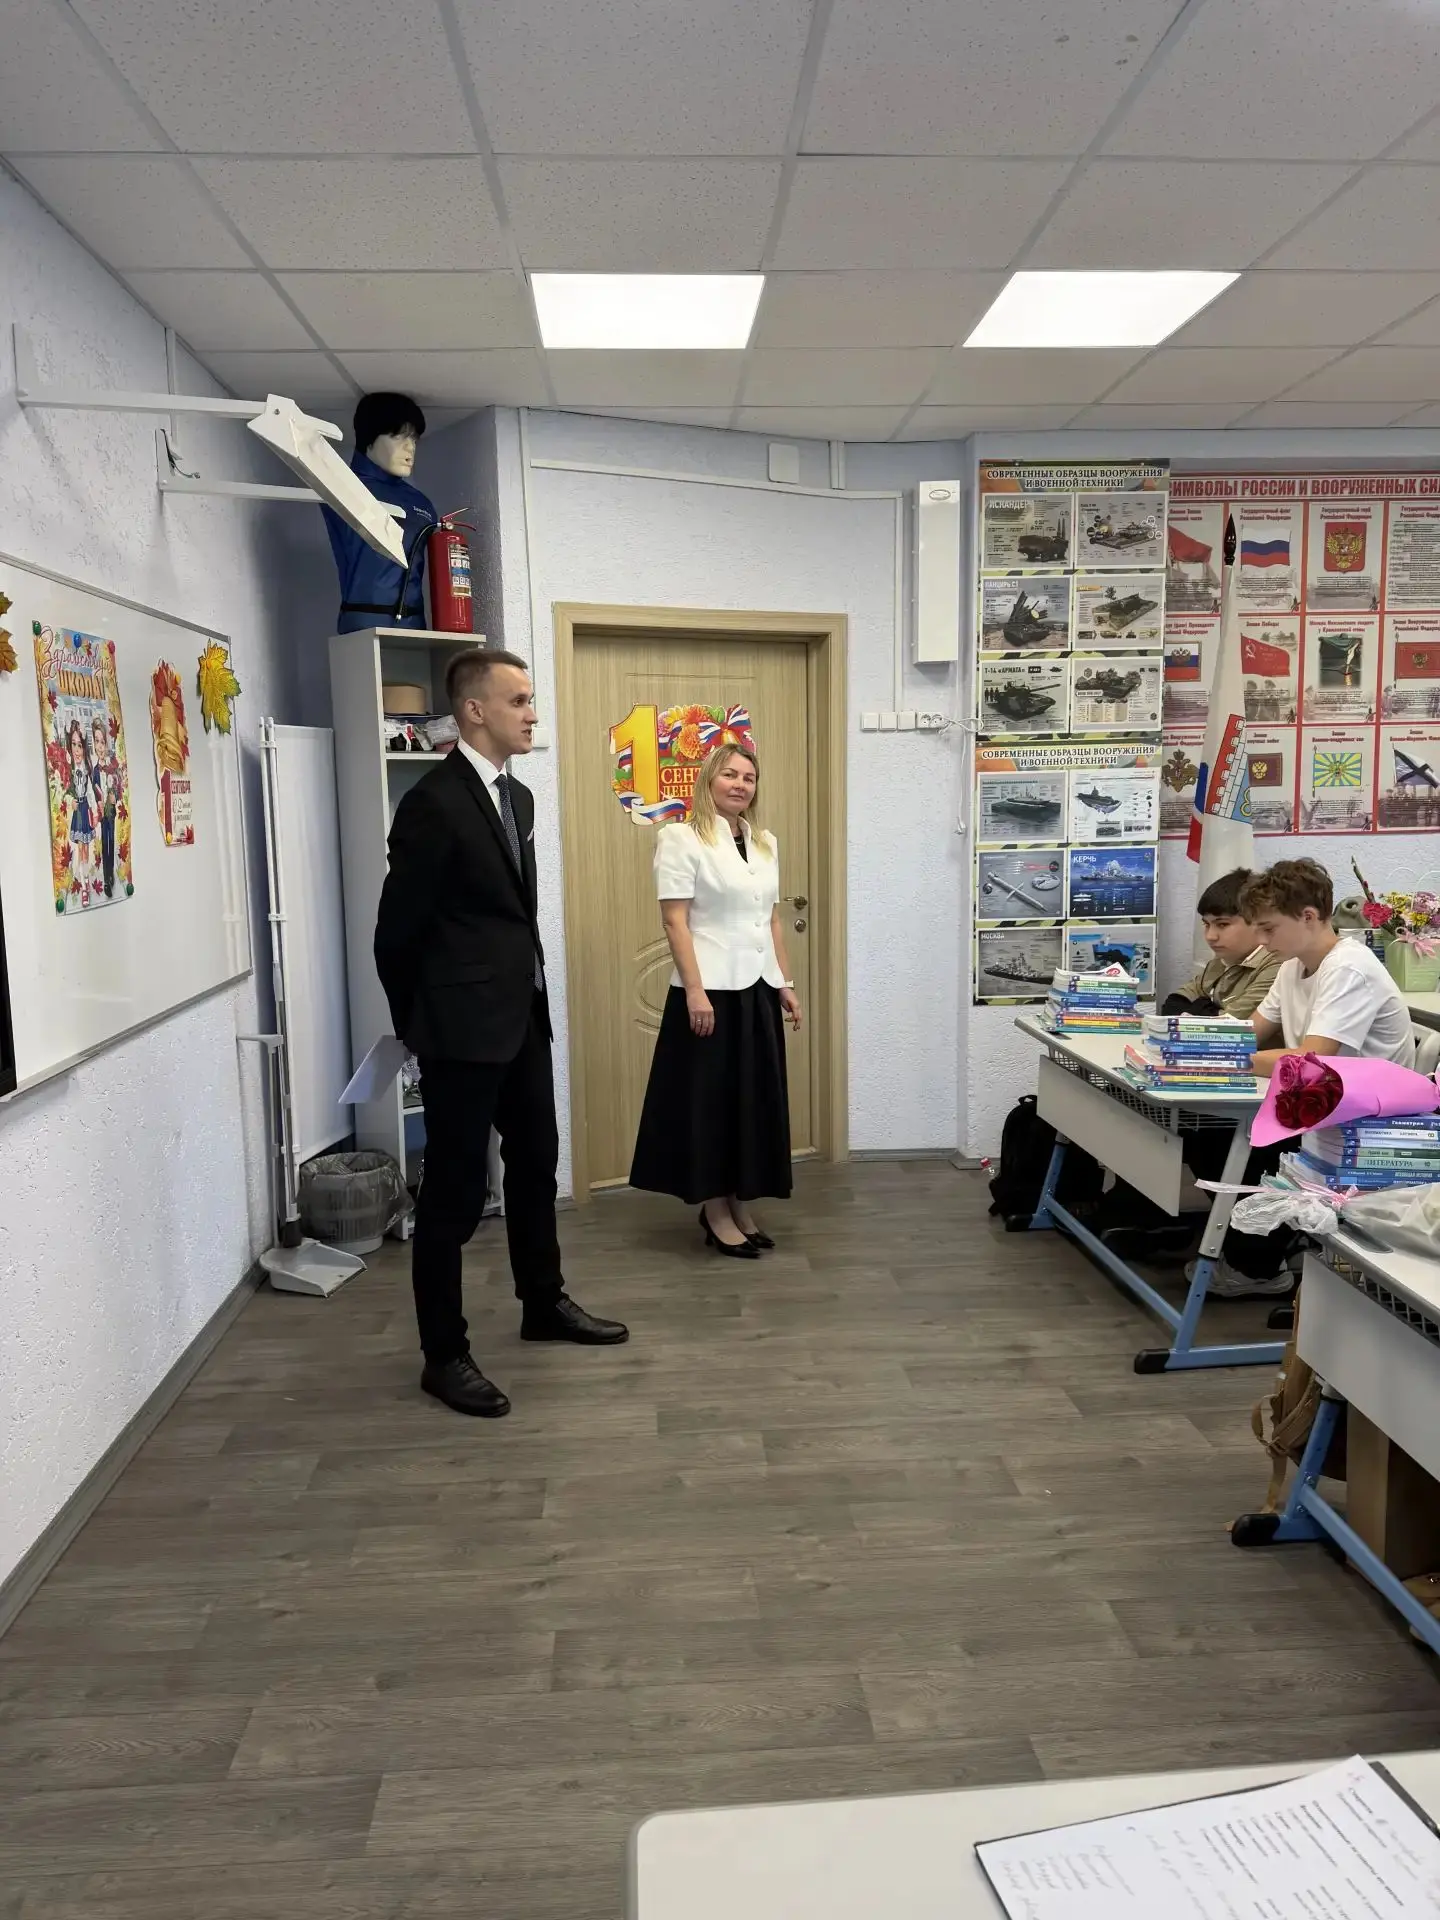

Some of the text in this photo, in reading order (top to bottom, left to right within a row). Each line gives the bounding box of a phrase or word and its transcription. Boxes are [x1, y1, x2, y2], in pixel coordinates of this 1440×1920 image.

[987, 469, 1163, 478] СОВРЕМЕННЫЕ ОБРАЗЦЫ ВООРУЖЕНИЯ
[1025, 478, 1125, 488] И ВОЕННОЙ ТЕХНИКИ
[1241, 480, 1296, 496] РОССИИ
[1299, 480, 1308, 496] И
[1311, 478, 1416, 495] ВООРУЖЕННЫХ
[1420, 478, 1440, 494] СИ
[989, 500, 1028, 510] ИСКАНДЕР
[609, 704, 660, 804] 1
[982, 746, 1155, 758] СОВРЕМЕННЫЕ ОБРАЗЦЫ ВООРУЖЕНИЯ
[1020, 756, 1117, 767] И ВОЕННОЙ ТЕХНИКИ
[1073, 855, 1097, 863] КЕРЧЬ
